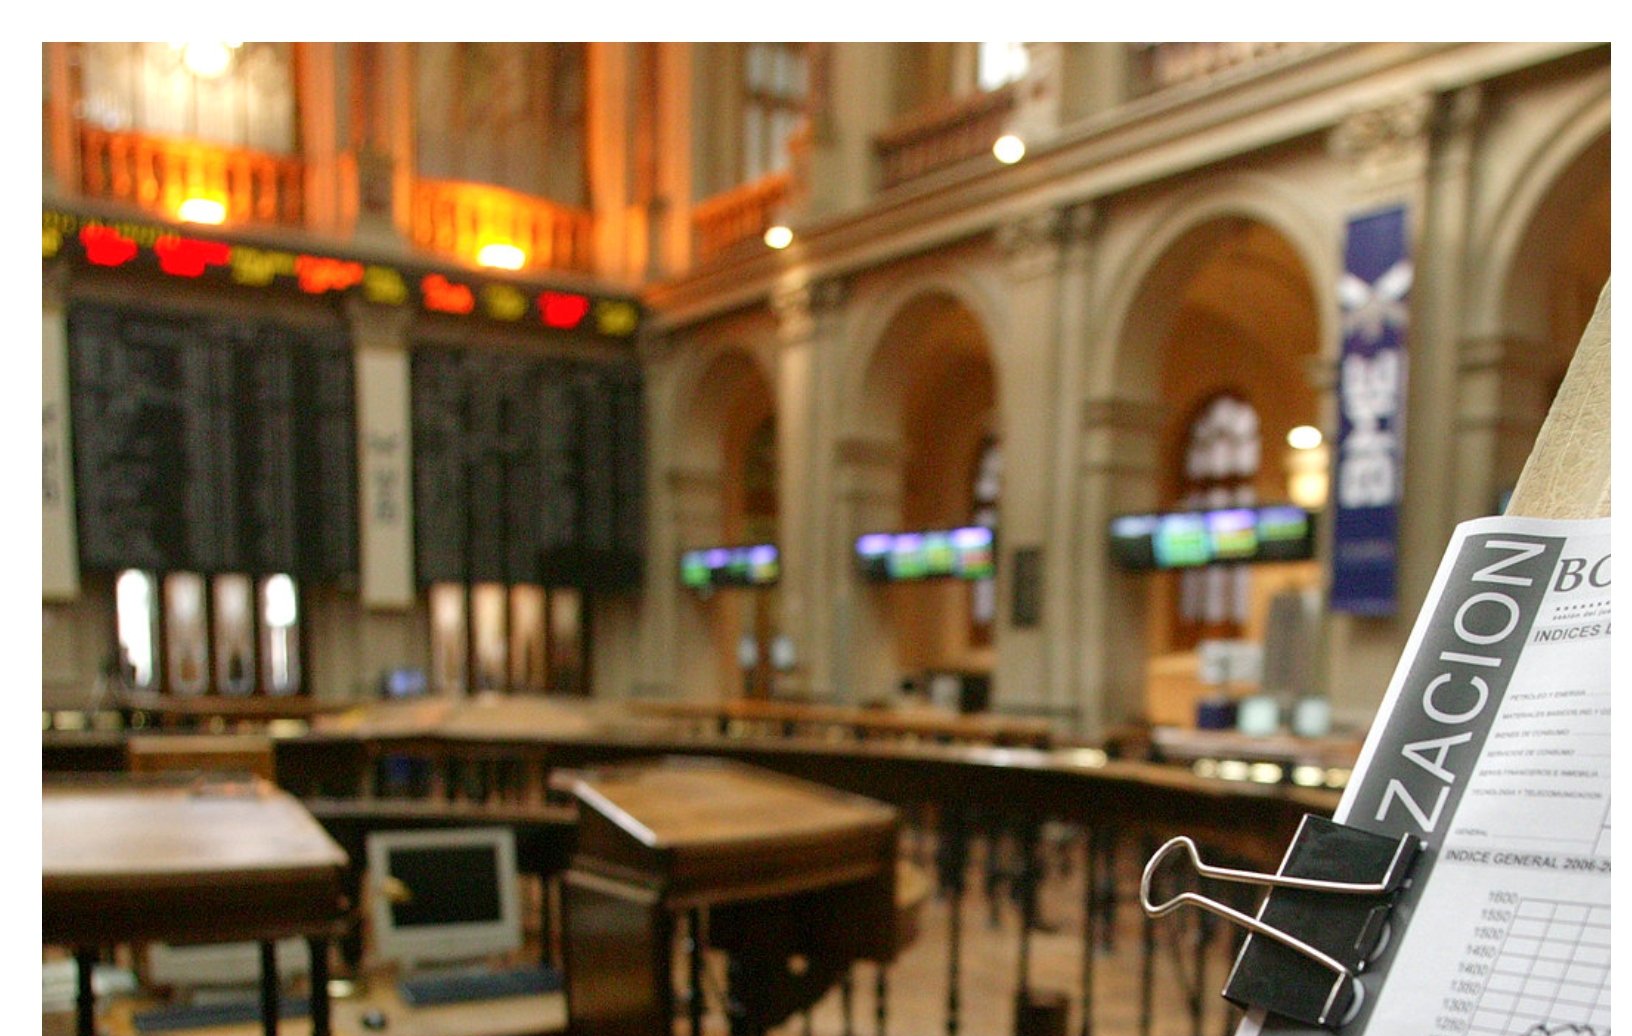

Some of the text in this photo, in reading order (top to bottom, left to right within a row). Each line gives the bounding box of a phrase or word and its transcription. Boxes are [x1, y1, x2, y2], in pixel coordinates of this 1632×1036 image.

[1534, 624, 1601, 642] INDICES
[1374, 540, 1546, 833] ZACION
[1446, 850, 1611, 873] INDICE GENERAL 2006-2
